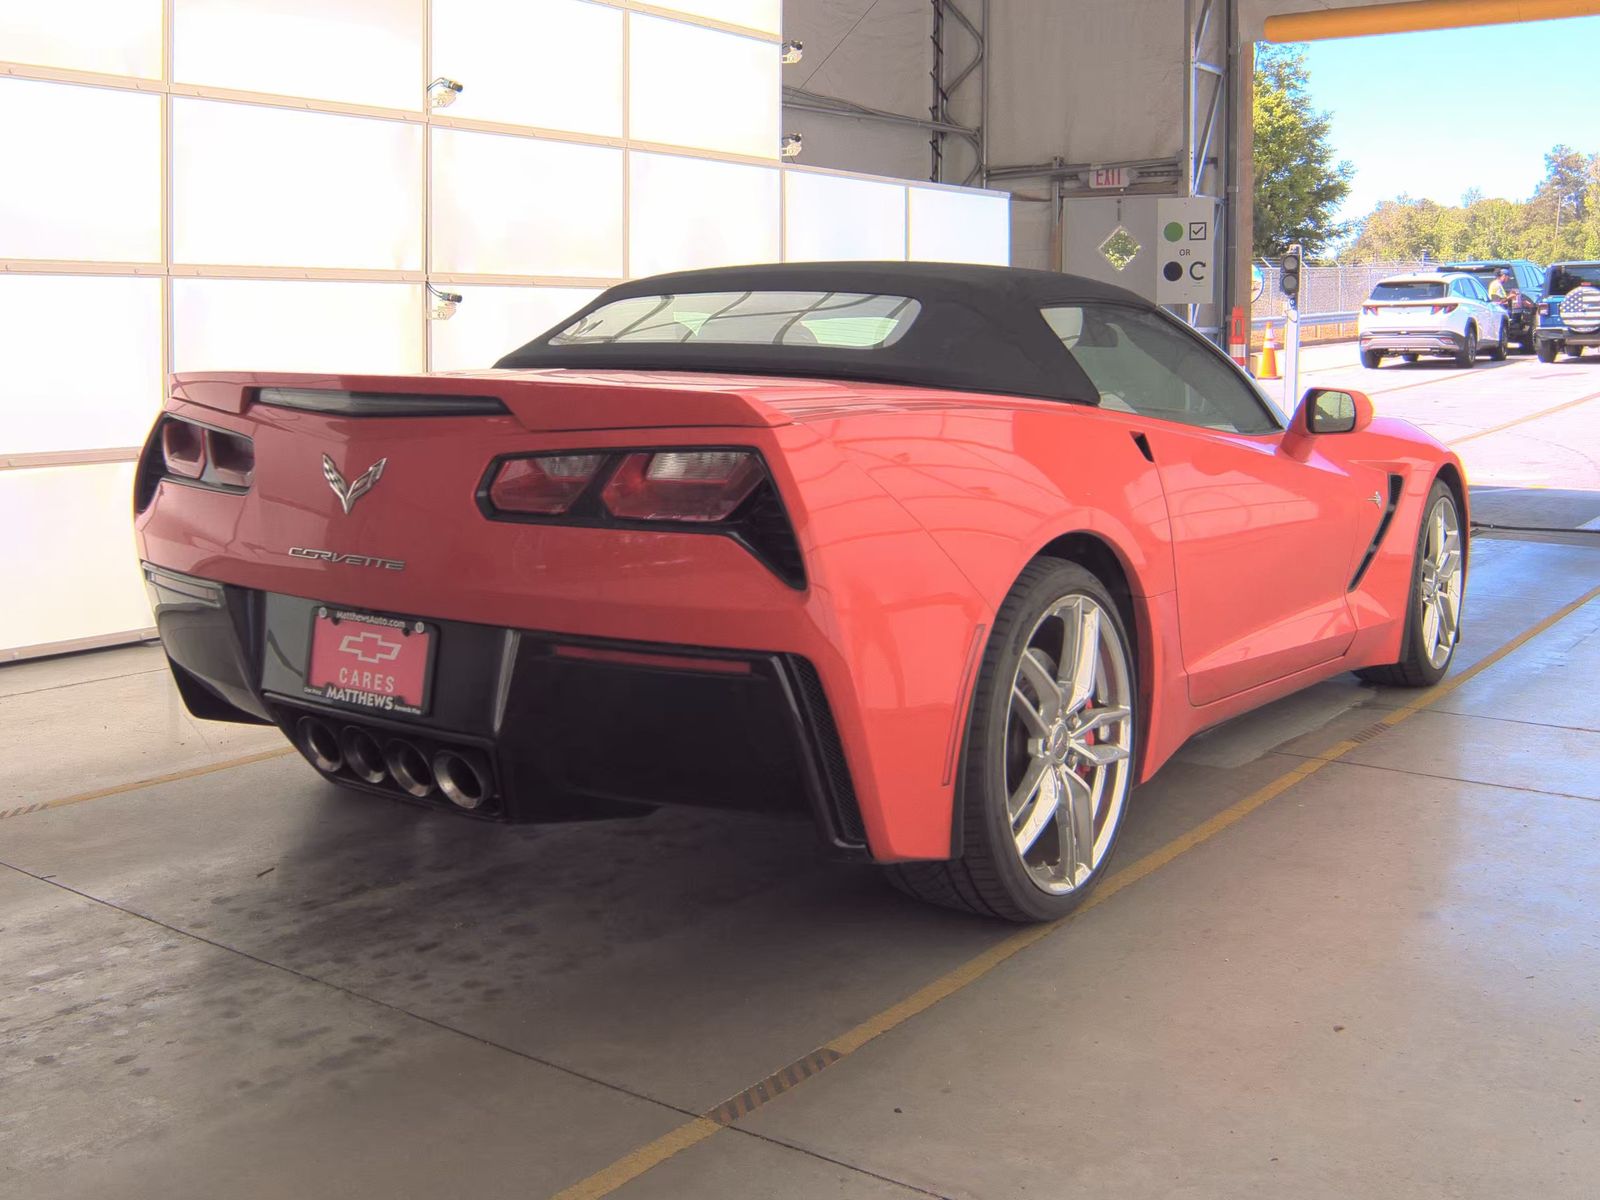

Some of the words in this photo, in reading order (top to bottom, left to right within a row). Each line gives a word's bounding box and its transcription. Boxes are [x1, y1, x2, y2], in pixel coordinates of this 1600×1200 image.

[1179, 249, 1191, 257] OR
[288, 547, 405, 570] CORVETTE
[339, 667, 395, 693] CARES
[326, 685, 394, 710] MATTHEWS
